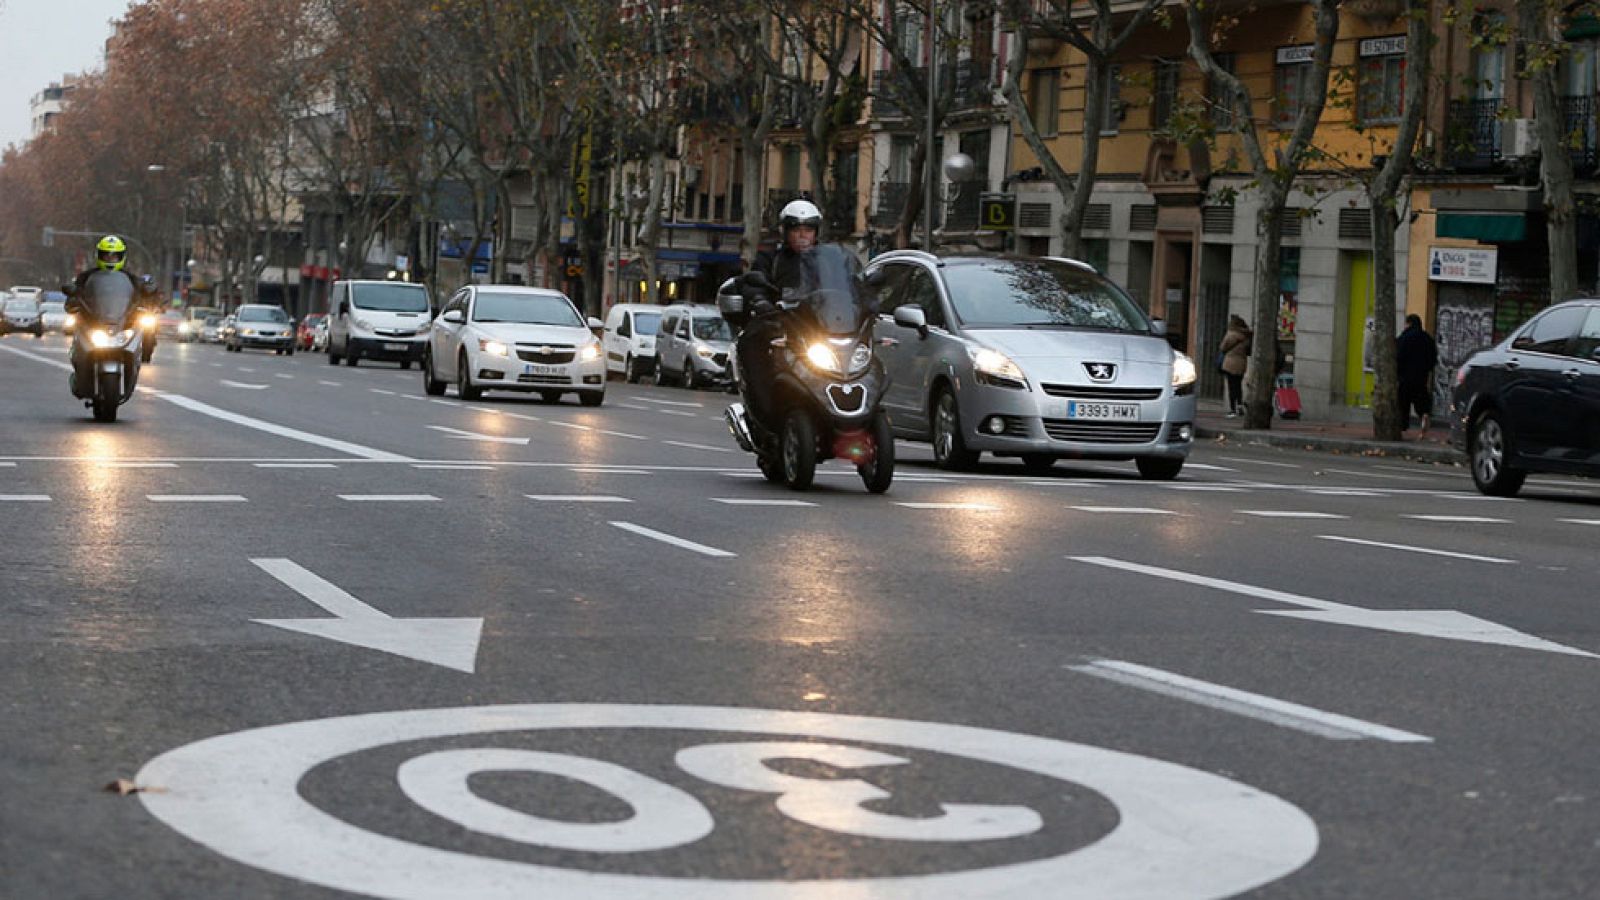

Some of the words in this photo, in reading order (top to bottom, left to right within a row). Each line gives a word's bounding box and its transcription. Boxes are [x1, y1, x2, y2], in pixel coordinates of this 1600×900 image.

[1077, 404, 1110, 417] 3393
[1112, 405, 1136, 418] HWX
[397, 741, 1044, 852] 30
